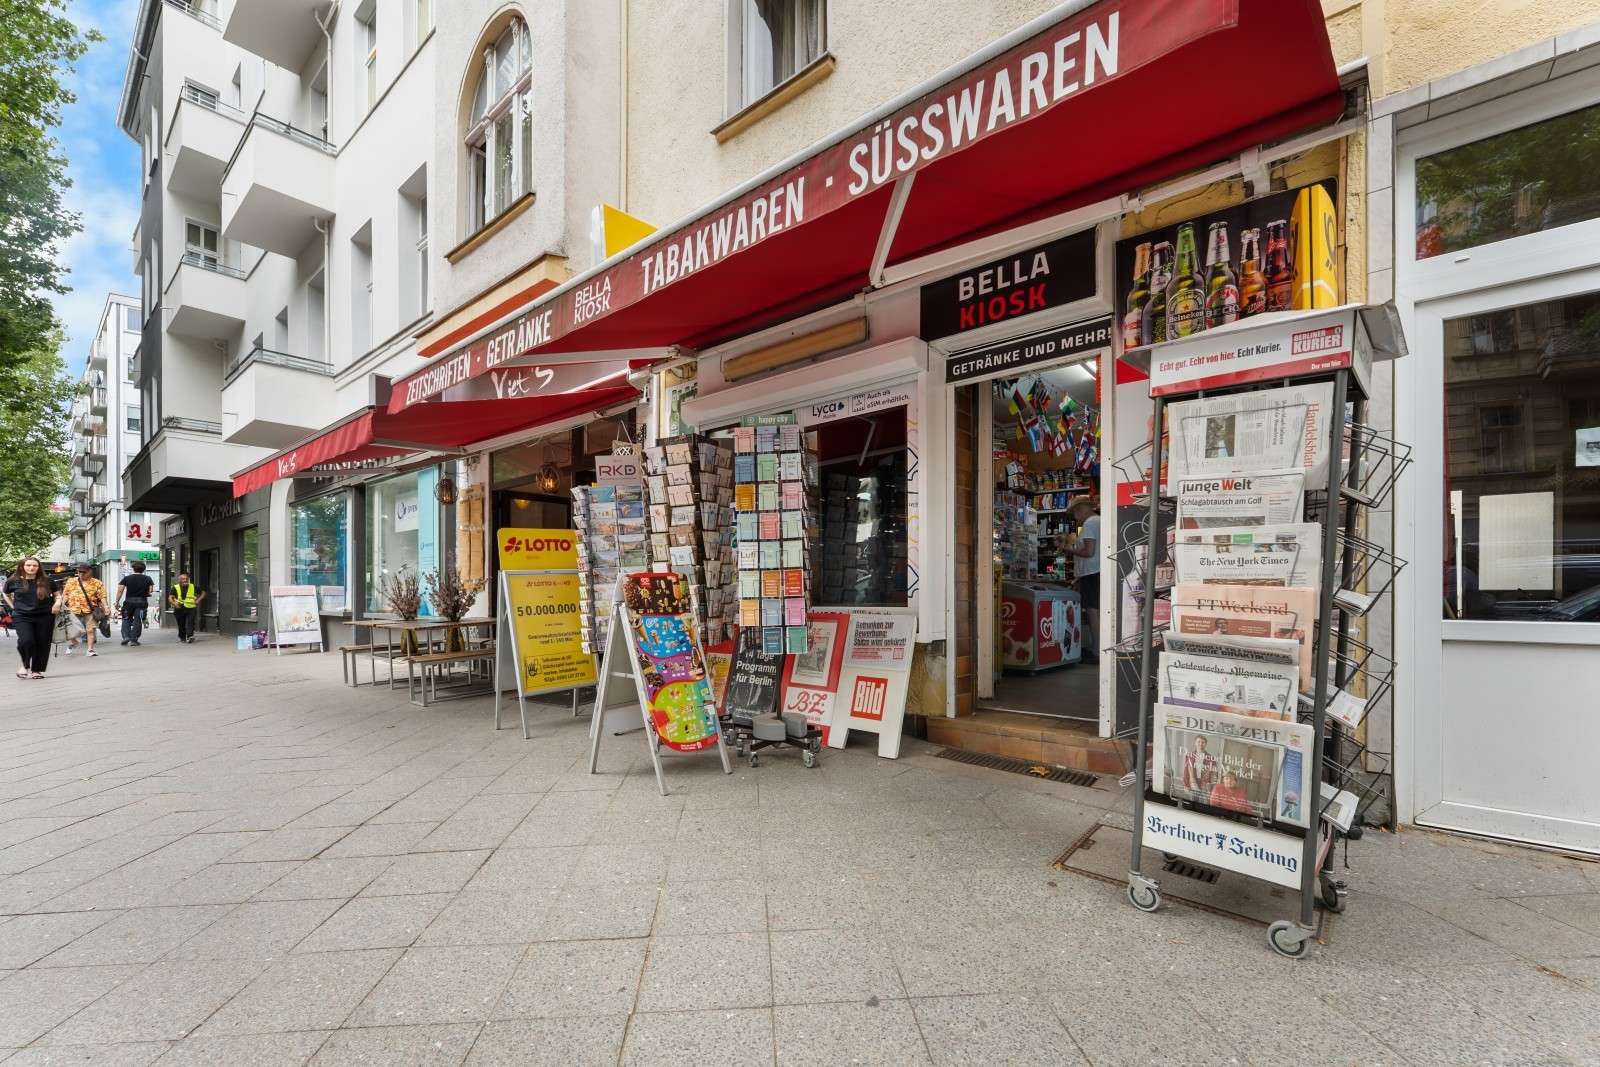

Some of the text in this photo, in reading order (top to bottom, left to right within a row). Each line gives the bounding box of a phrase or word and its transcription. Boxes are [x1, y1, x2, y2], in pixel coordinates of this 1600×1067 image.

[848, 12, 1119, 196] SÜSSWAREN
[642, 177, 805, 296] TABAKWAREN
[958, 251, 1050, 301] BELLA
[574, 276, 612, 307] BELLA
[574, 293, 612, 325] KIOSK
[959, 283, 1047, 329] KIOSK
[486, 310, 553, 368] GETRÄNKE
[952, 350, 1020, 376] GETRÄNKE
[1025, 340, 1056, 359] UND
[1061, 327, 1113, 350] MEHR!
[1294, 334, 1341, 354] KURIER
[1160, 362, 1174, 372] Echt
[1189, 357, 1204, 366] Echt
[1206, 355, 1218, 364] von
[1237, 347, 1254, 358] Echt
[1256, 342, 1281, 355] Kurier.
[406, 350, 471, 406] ZEITSCHRIFTEN
[867, 392, 882, 400] Auch
[812, 402, 836, 418] Lyca
[598, 464, 636, 476] RKD
[1182, 478, 1252, 494] junge Welt
[1248, 496, 1262, 504] Golf
[525, 538, 572, 552] LOTTO
[1200, 556, 1289, 568] The New York Times
[517, 603, 576, 616] 50.000.000
[736, 660, 776, 674] Programm
[736, 674, 773, 686] für Berlin
[855, 680, 883, 714] Bild
[1186, 716, 1280, 742] DIE ZEIT
[1224, 754, 1244, 768] Bild
[1246, 758, 1264, 770] der
[1146, 815, 1298, 874] Berliner Zeitung
